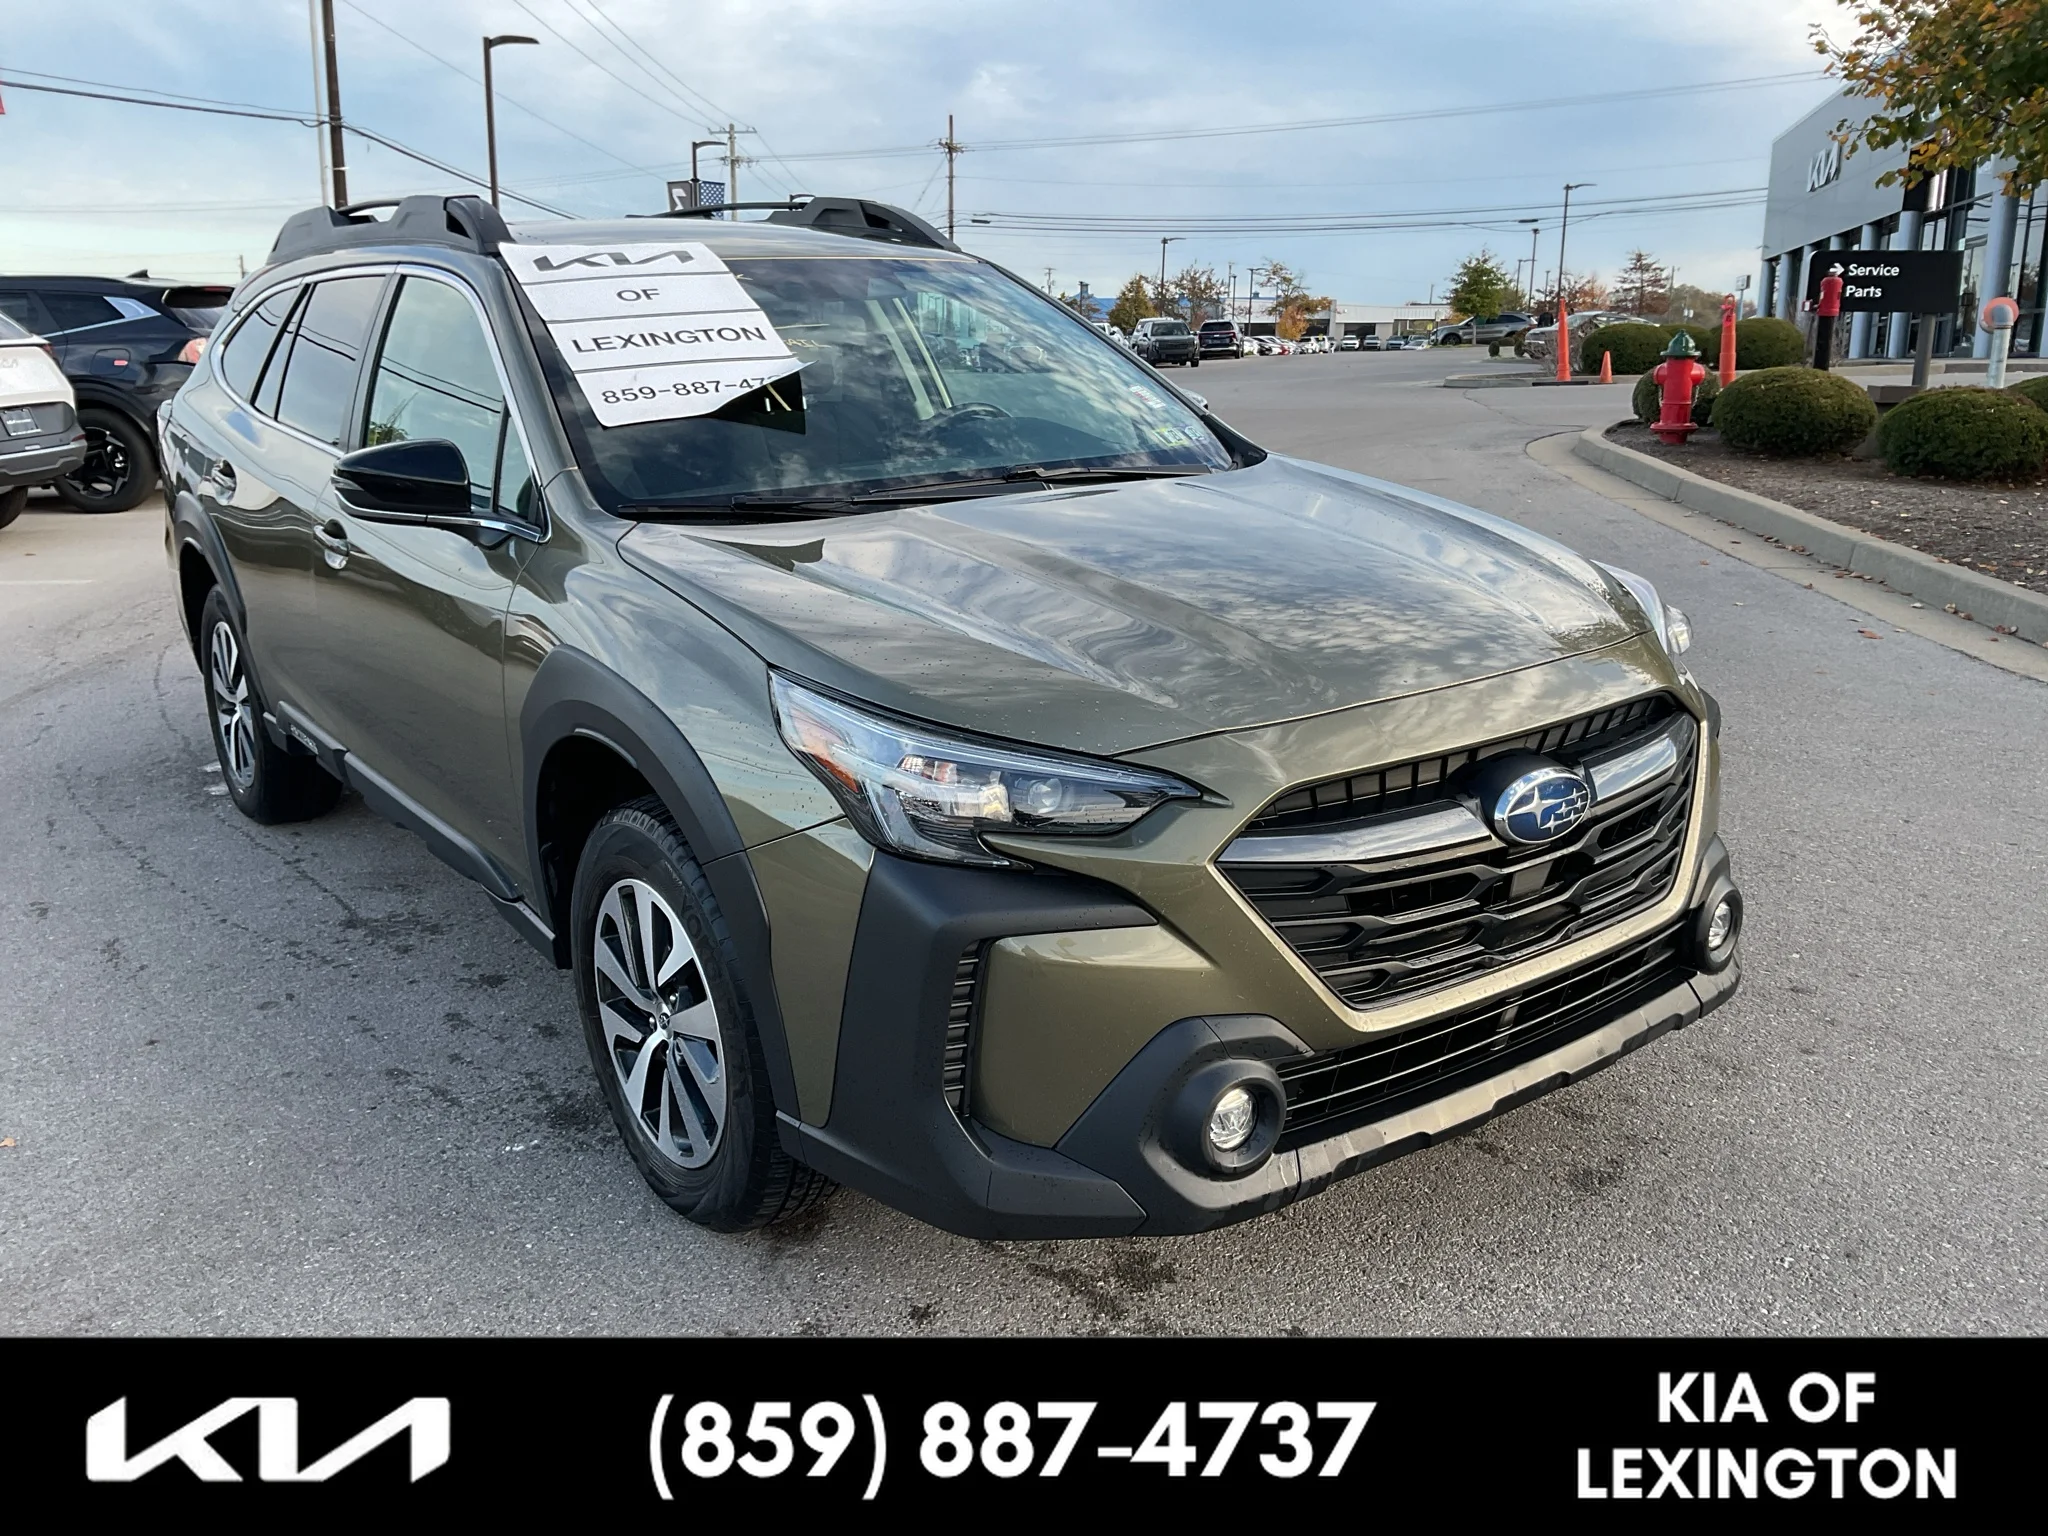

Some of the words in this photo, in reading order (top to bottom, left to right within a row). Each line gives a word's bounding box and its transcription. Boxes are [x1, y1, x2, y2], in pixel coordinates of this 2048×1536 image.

[1805, 139, 1841, 193] KIA
[532, 250, 695, 272] KIA
[1848, 263, 1900, 276] Service
[615, 288, 660, 302] OF
[1845, 285, 1882, 298] Parts
[571, 326, 768, 353] LEXINGTON
